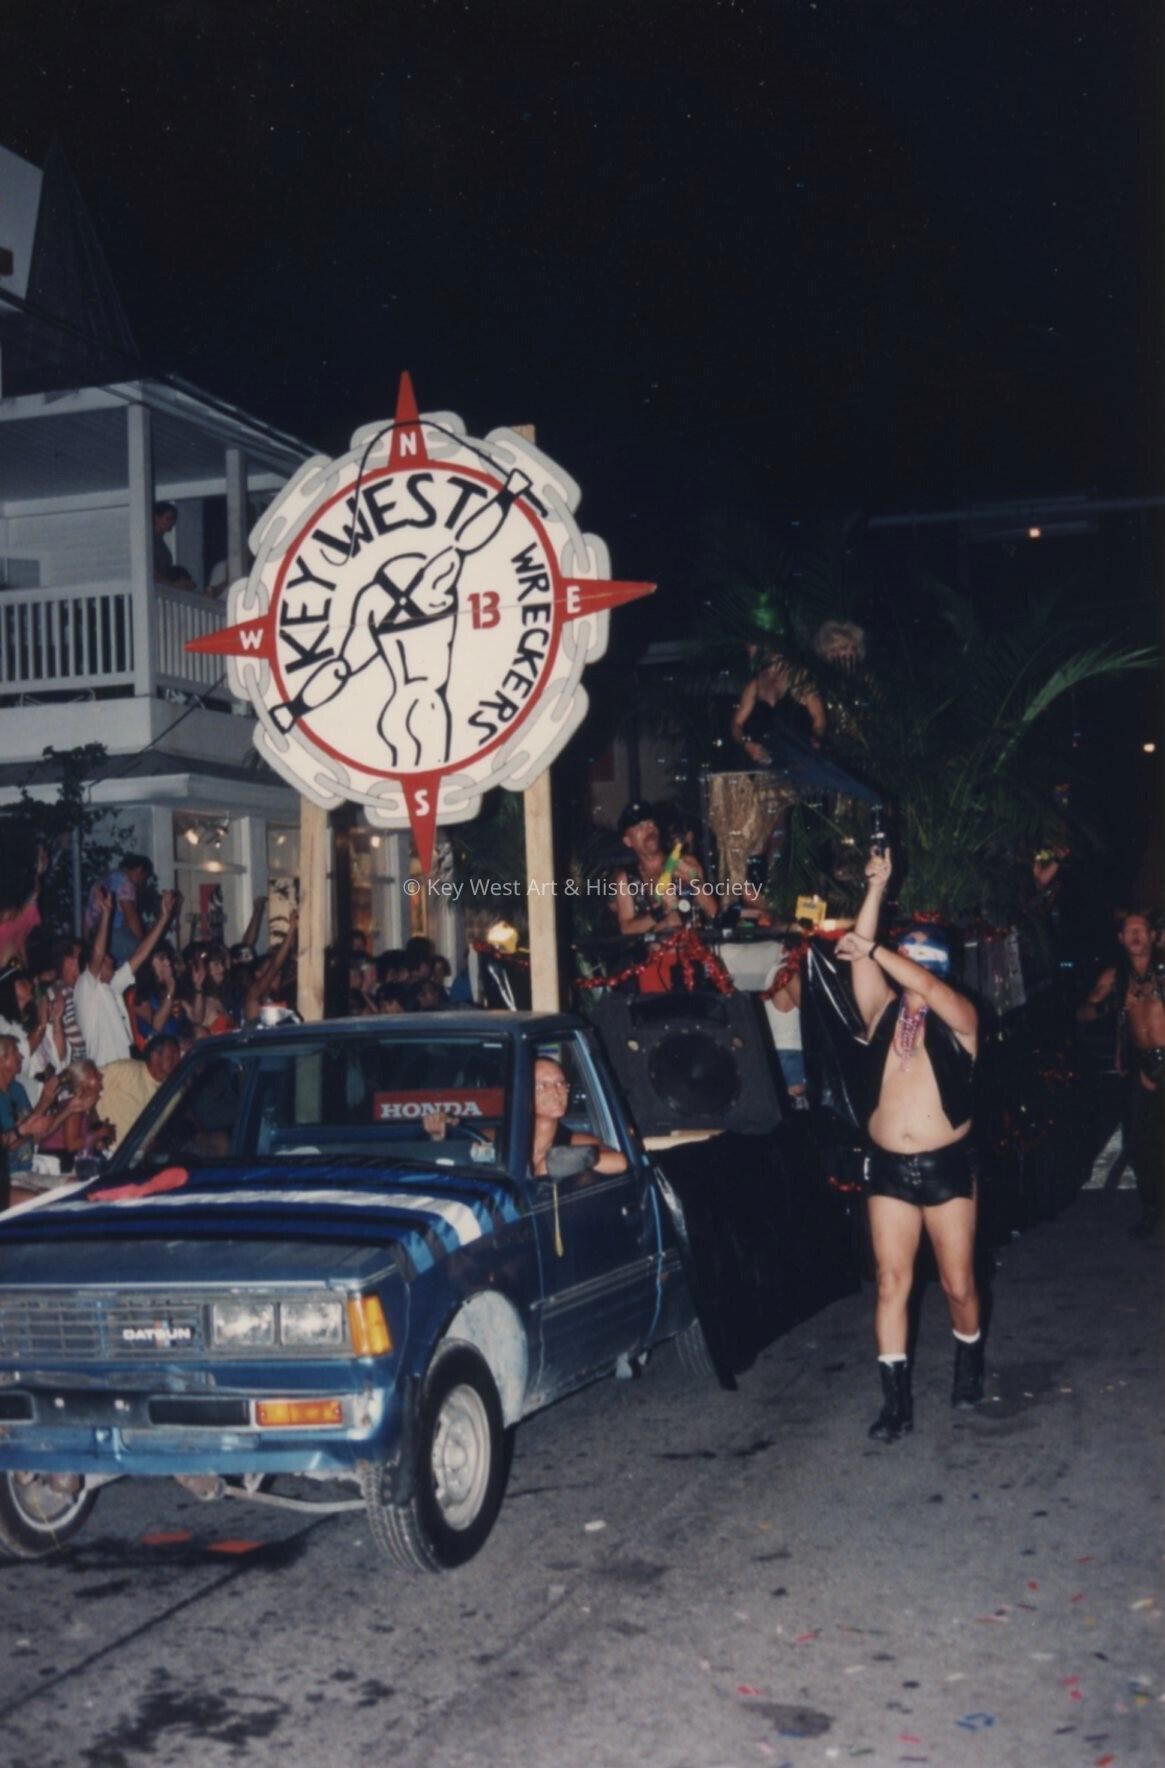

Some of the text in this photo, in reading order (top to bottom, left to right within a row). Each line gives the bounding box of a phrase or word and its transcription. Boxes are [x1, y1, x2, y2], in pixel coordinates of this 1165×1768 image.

[400, 432, 416, 455] N
[279, 472, 488, 674] KEY WEST
[467, 591, 501, 630] 13
[566, 586, 581, 614] E
[240, 630, 263, 650] W
[468, 542, 552, 746] WRECKERS
[414, 790, 429, 817] S
[381, 1101, 482, 1118] HONDA
